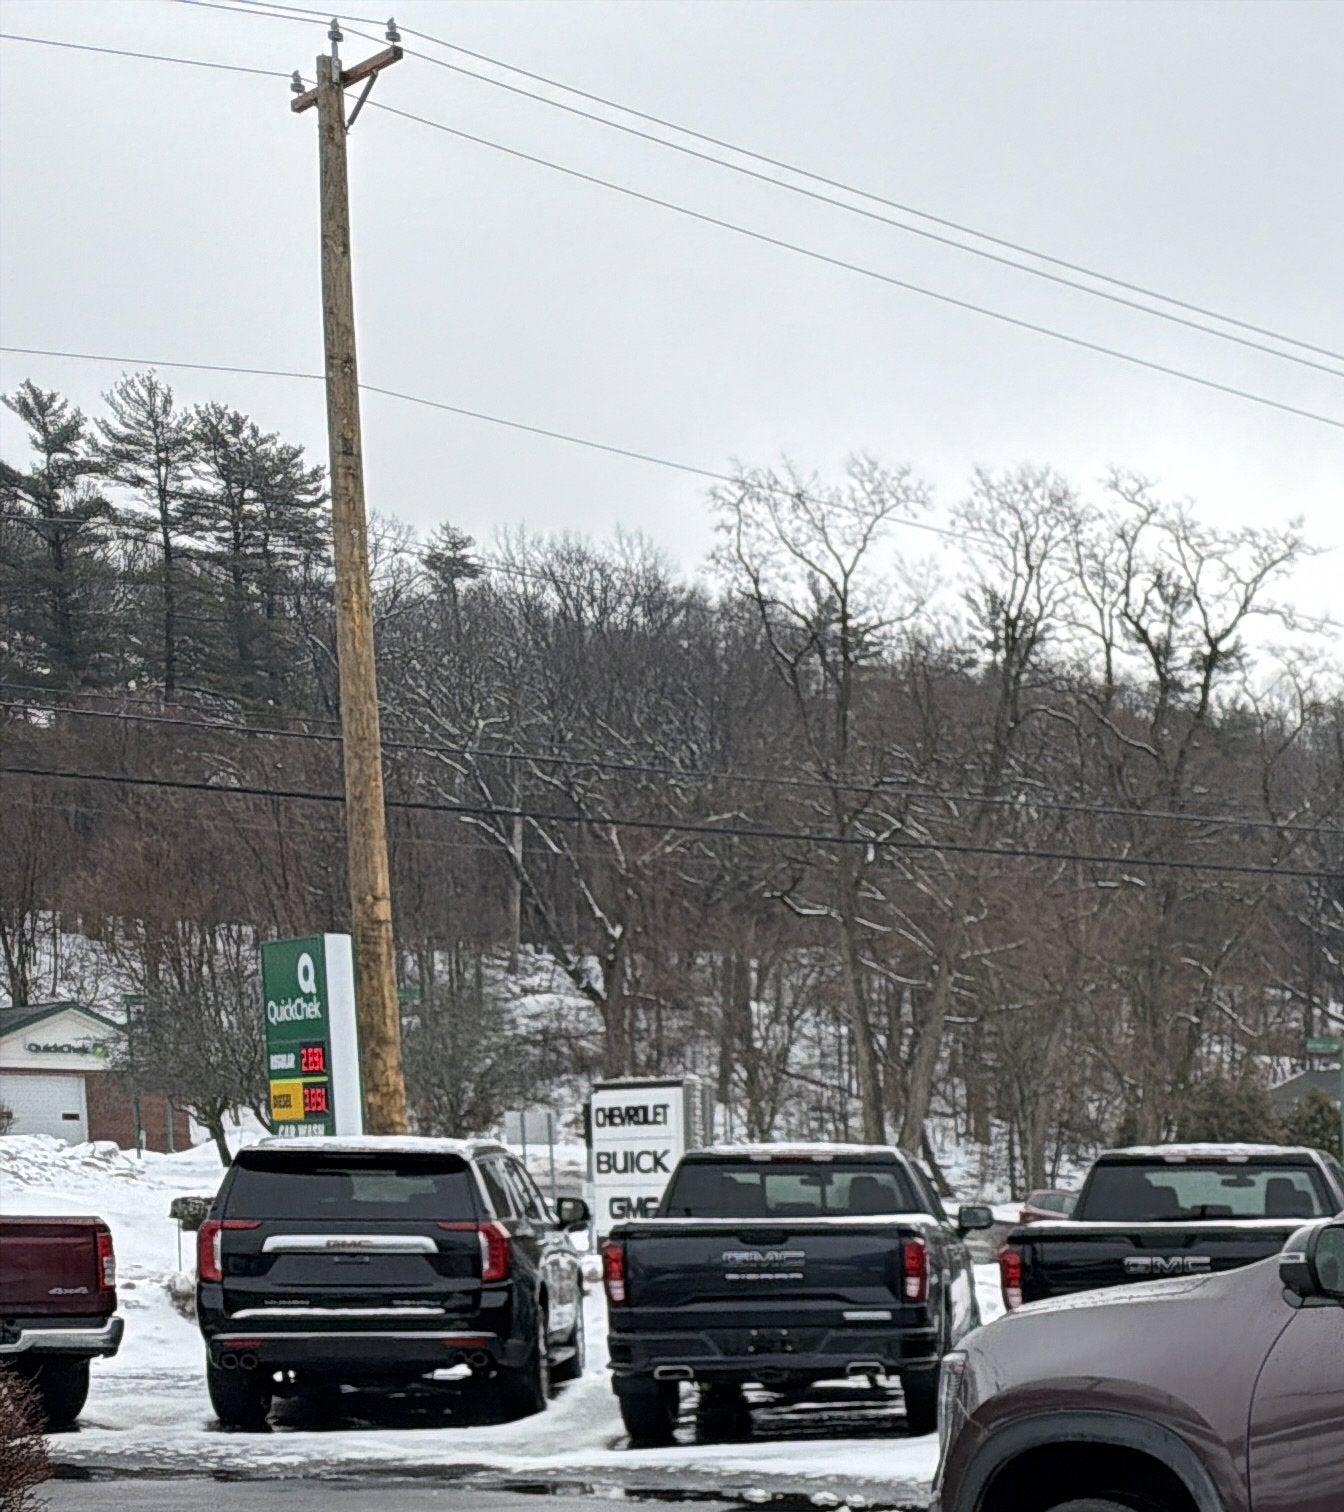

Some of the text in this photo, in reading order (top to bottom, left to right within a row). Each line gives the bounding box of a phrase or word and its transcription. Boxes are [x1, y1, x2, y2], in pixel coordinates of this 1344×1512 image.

[297, 953, 317, 994] Q
[267, 996, 322, 1026] QuickChek
[595, 1104, 670, 1128] CHEVROLET
[278, 1123, 325, 1136] CAR WASH
[596, 1149, 671, 1174] BUICK
[722, 1250, 806, 1268] GMC
[1122, 1256, 1212, 1275] GMC
